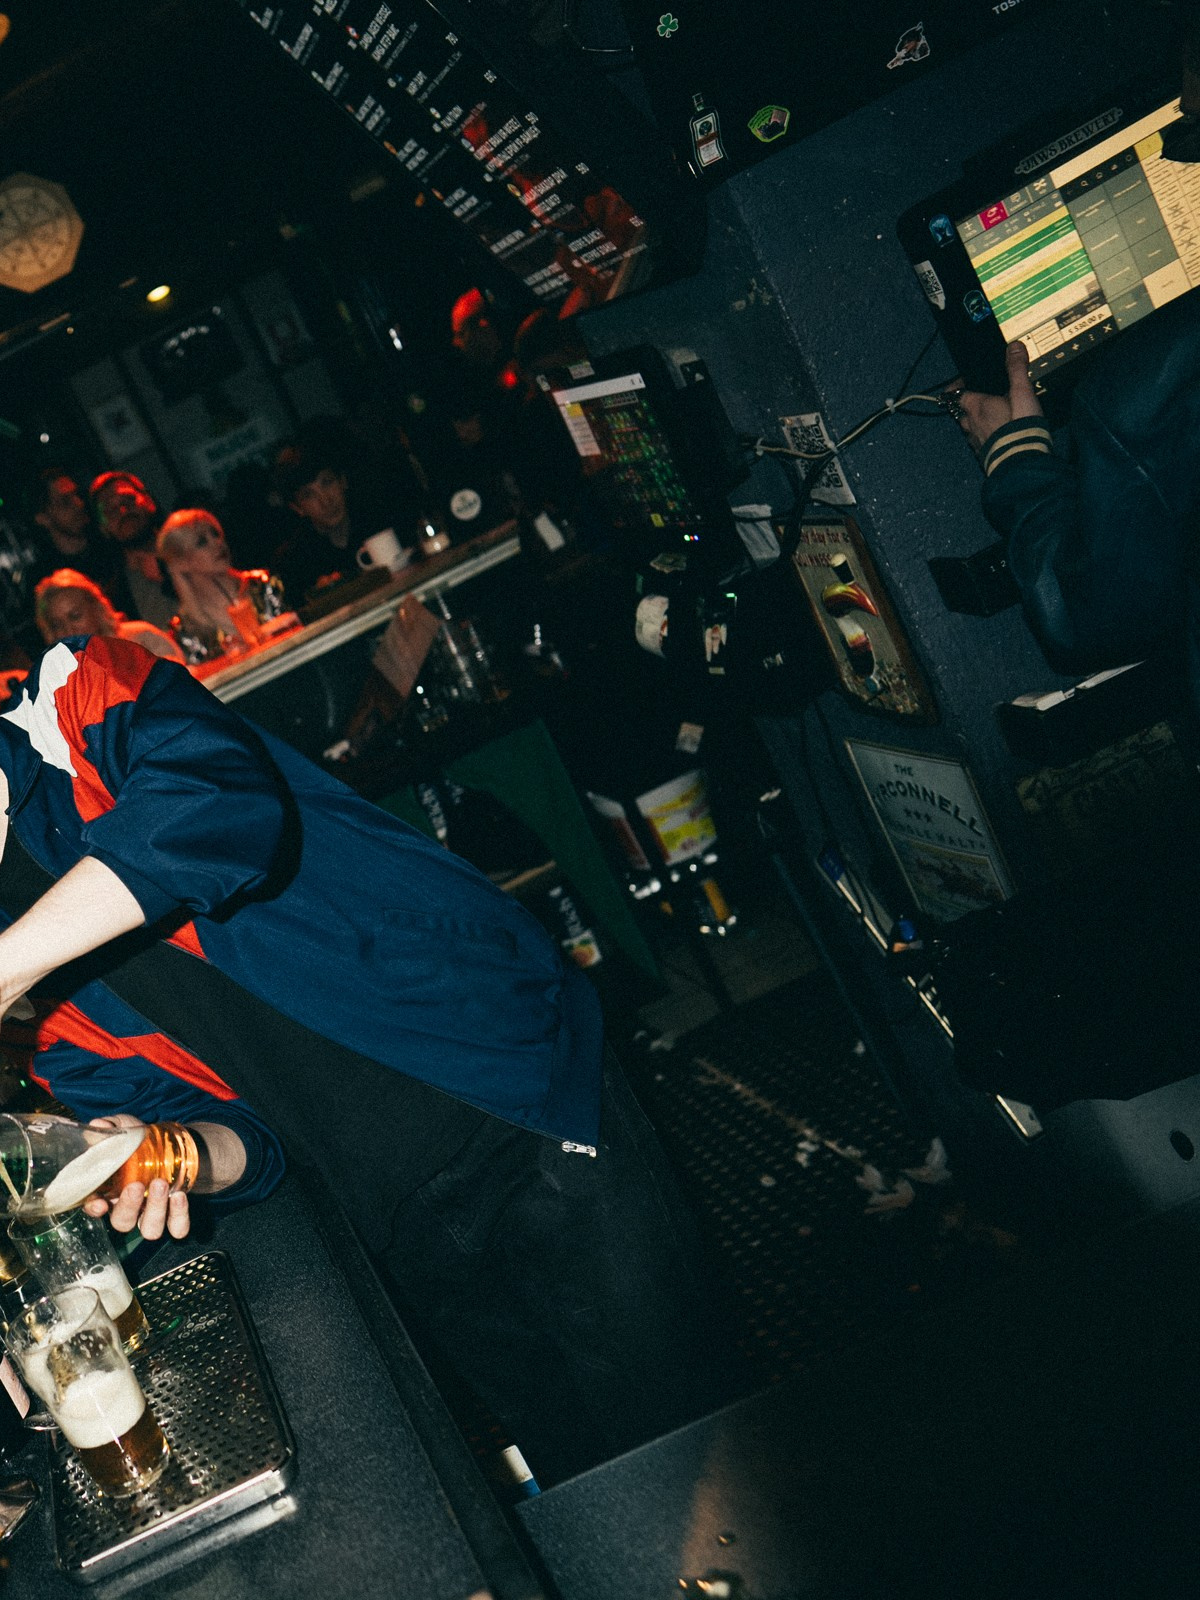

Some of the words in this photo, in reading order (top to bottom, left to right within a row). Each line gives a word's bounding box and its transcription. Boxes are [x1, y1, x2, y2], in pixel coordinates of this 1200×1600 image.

[992, 0, 1023, 14] TOS
[1021, 143, 1058, 171] JAWS
[1058, 112, 1116, 151] BREWERY
[894, 764, 914, 777] THE
